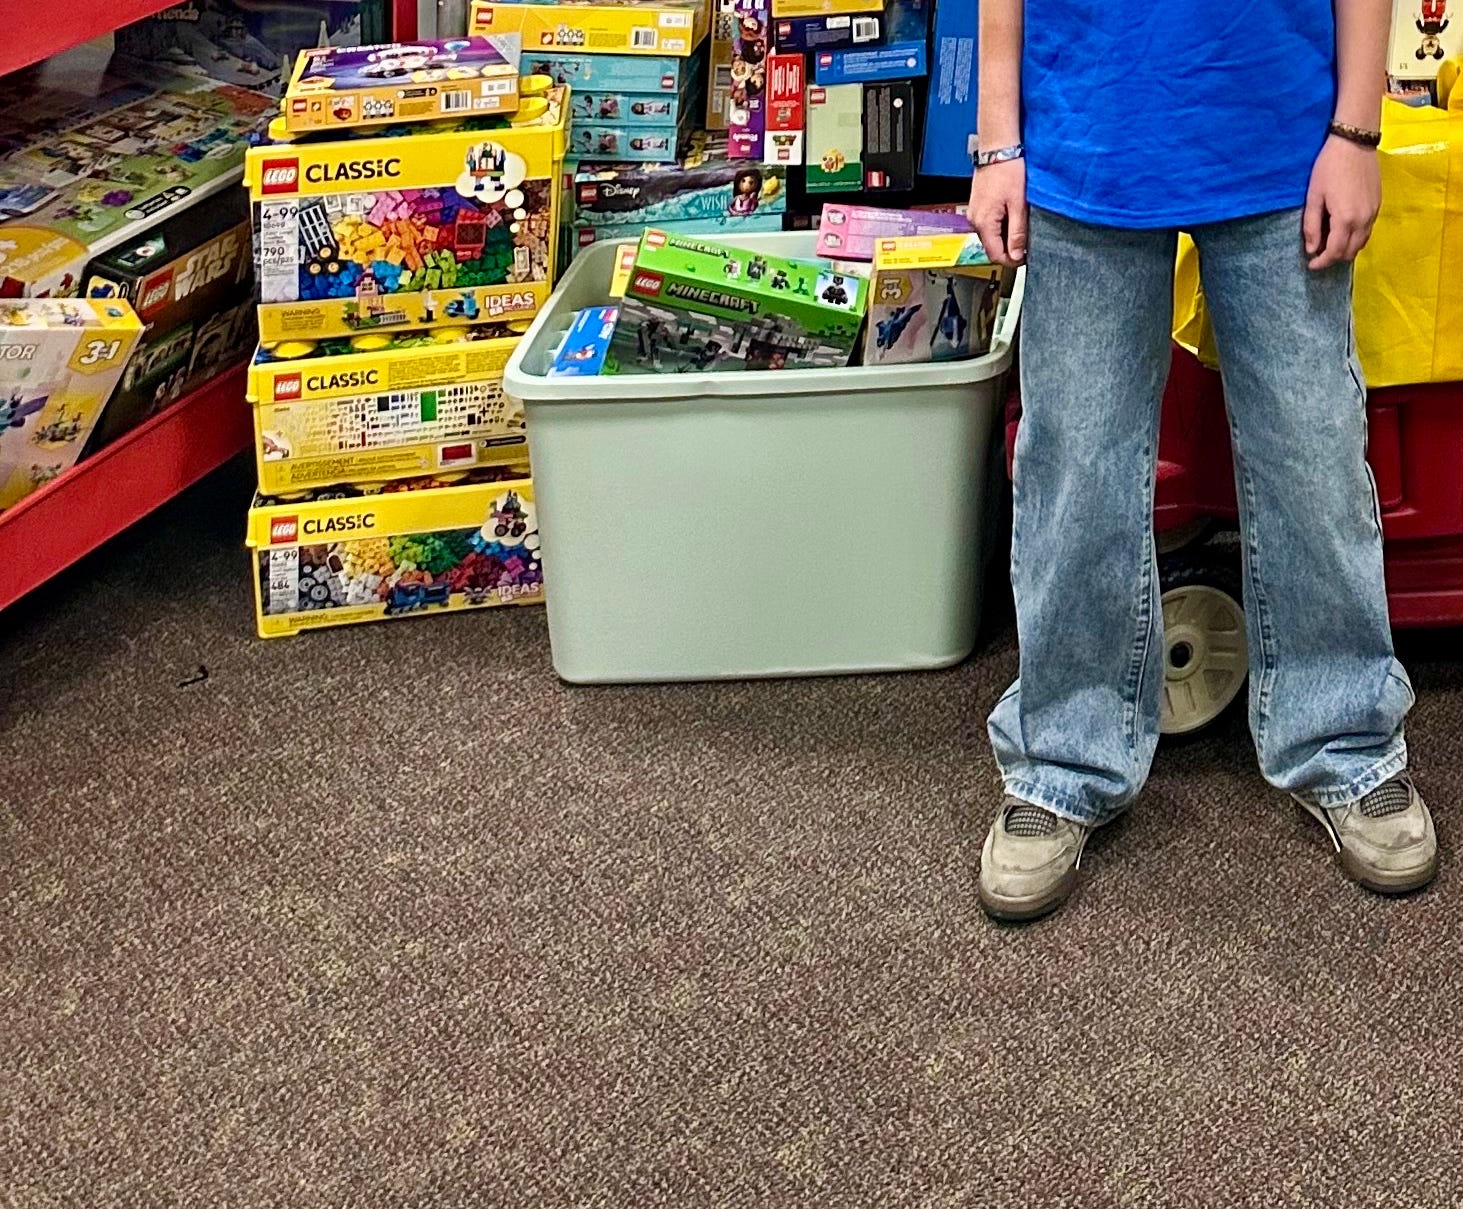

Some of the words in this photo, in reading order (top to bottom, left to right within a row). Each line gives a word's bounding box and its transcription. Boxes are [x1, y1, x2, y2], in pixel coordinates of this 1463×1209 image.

[147, 2, 200, 22] iends
[263, 167, 297, 185] LEGO
[305, 158, 401, 183] CLASSIC
[600, 183, 640, 198] Disney
[701, 194, 728, 210] WISH
[263, 207, 298, 221] 4-99
[176, 233, 239, 281] STAR
[263, 247, 284, 256] 790
[669, 238, 730, 258] MINECRAFT
[175, 256, 235, 302] WARS
[485, 292, 534, 308] IDEAS
[634, 277, 661, 290] LEGO
[666, 282, 760, 313] MINECRAFT
[274, 379, 300, 394] LEGO
[306, 369, 379, 391] CLASSIC
[272, 522, 297, 536] LEGO
[303, 513, 376, 534] CLASSIC
[271, 551, 298, 561] 4-99
